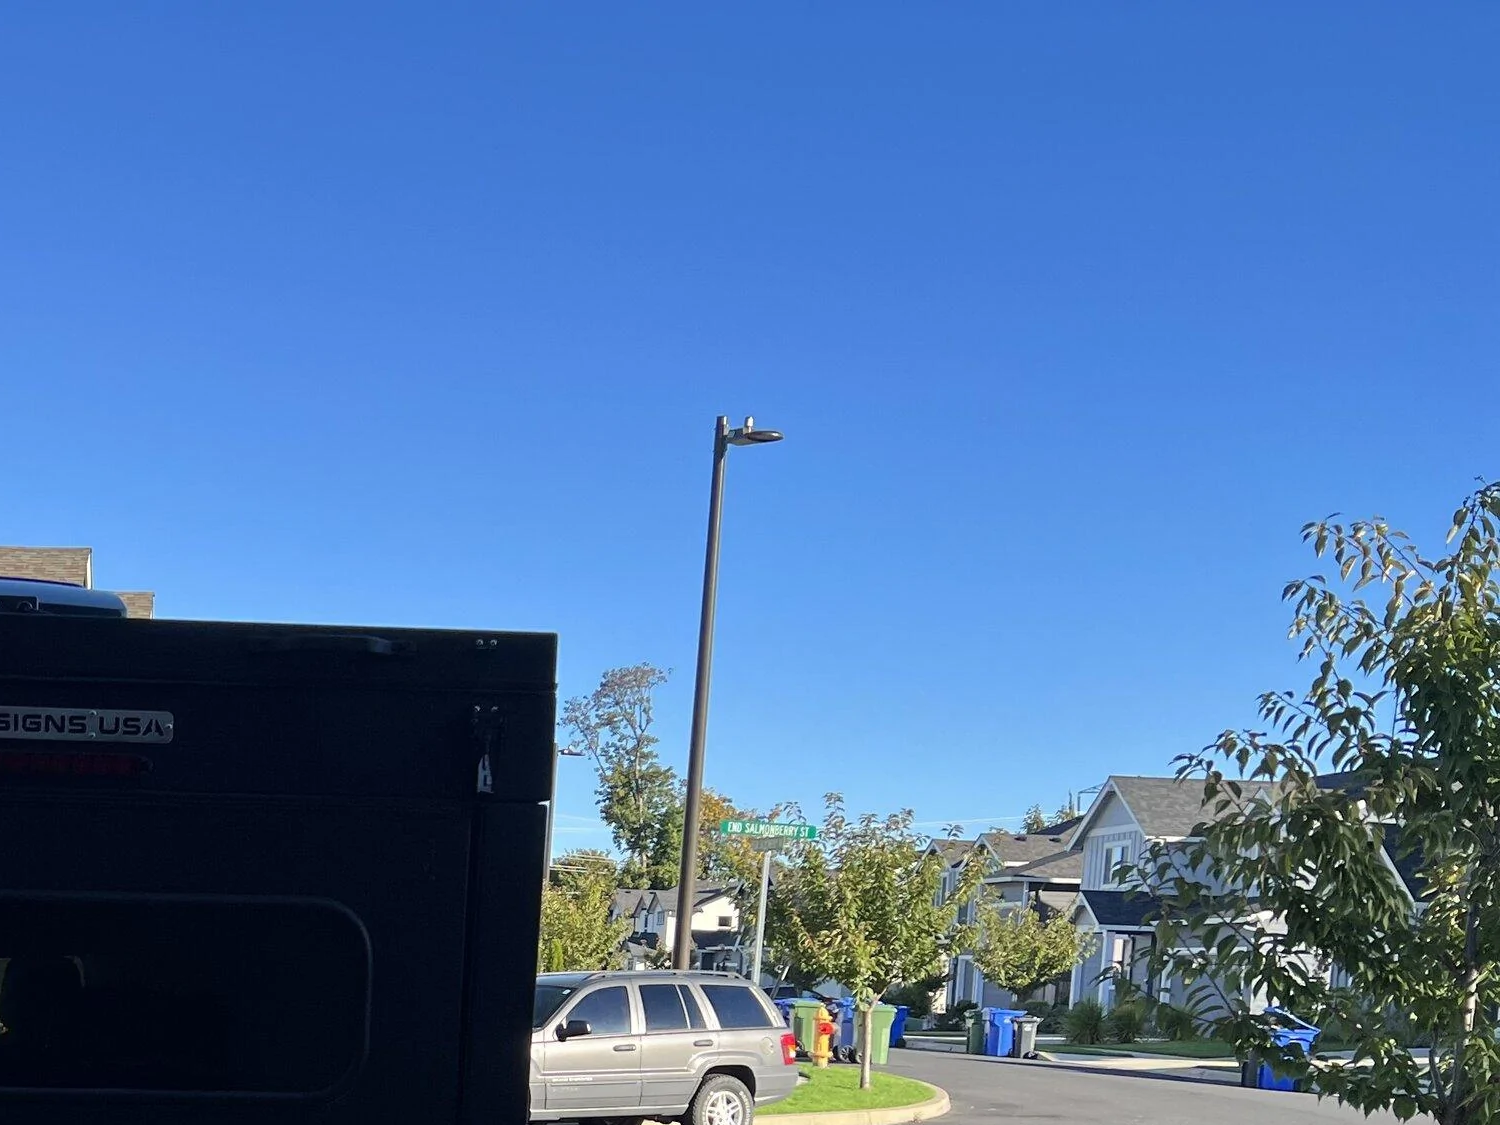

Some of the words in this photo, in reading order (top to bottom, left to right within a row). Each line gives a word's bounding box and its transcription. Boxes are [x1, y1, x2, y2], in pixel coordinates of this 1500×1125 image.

[99, 716, 166, 737] USA
[745, 823, 798, 837] SALMONBERRY
[800, 826, 810, 837] ST
